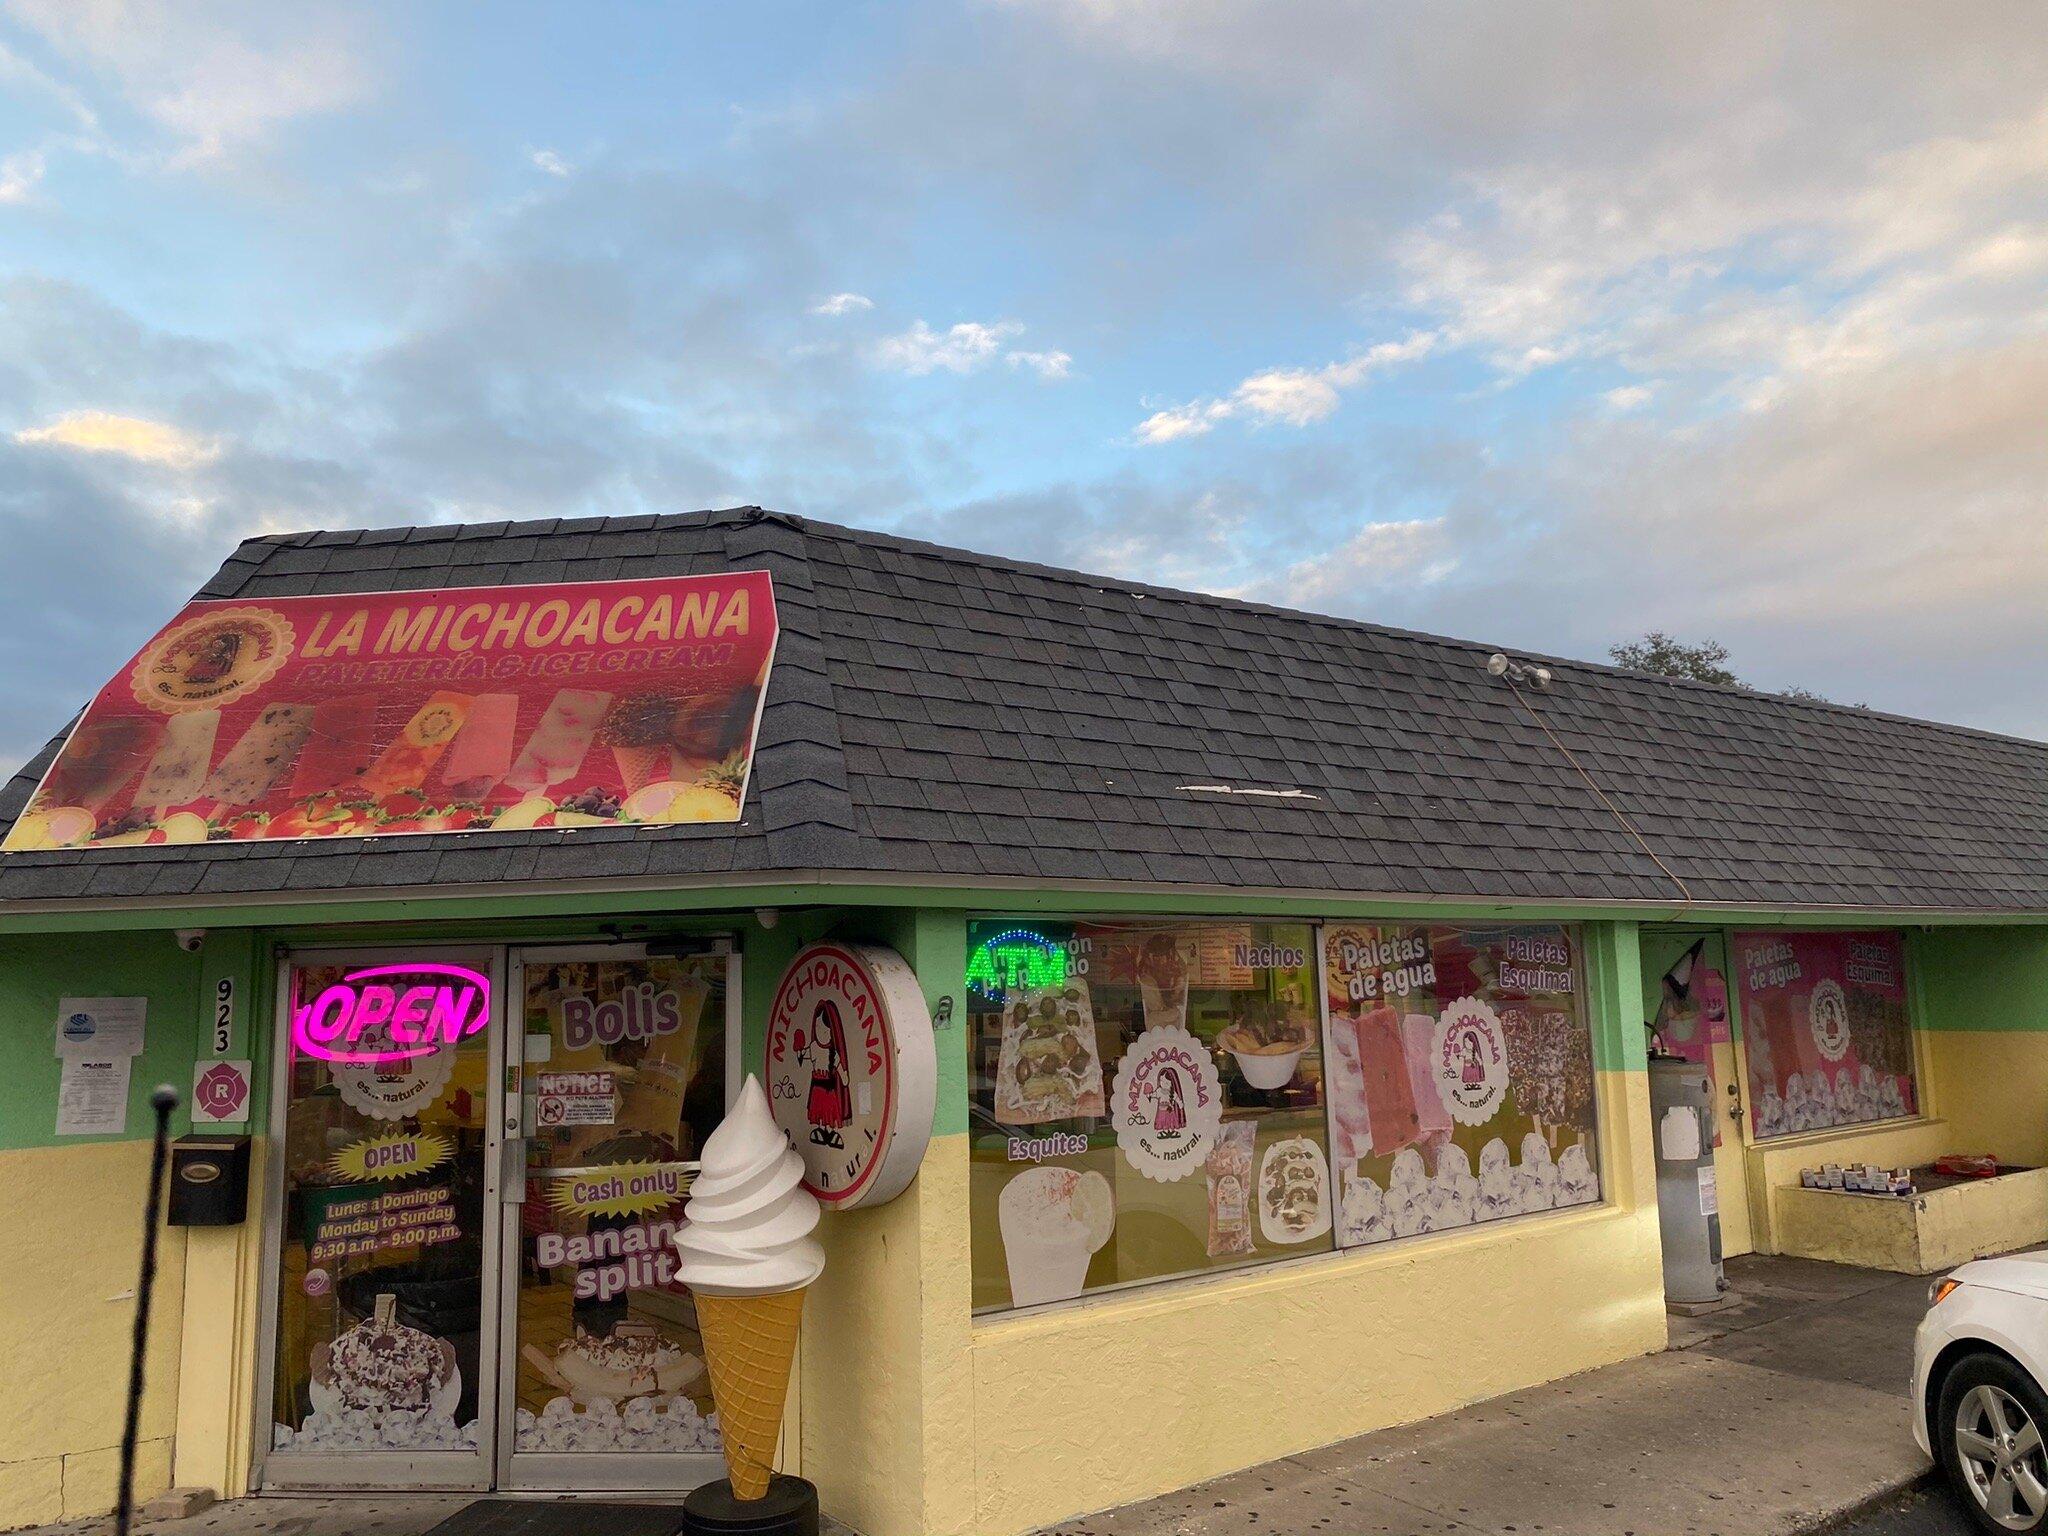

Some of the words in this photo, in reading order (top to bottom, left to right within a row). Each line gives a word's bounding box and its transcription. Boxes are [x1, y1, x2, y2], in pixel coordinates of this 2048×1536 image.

[300, 610, 369, 658] LA
[373, 588, 749, 654] MICHOACANA
[491, 654, 524, 679] &
[528, 652, 595, 676] ICE
[599, 642, 735, 673] CREAM
[182, 678, 244, 699] natural.
[965, 946, 1065, 987] ATM
[1234, 942, 1304, 968] Nachos
[1343, 936, 1425, 972] Paletas
[1506, 934, 1568, 966] Paletas
[1745, 941, 1794, 969] Paletas
[1349, 970, 1377, 1000] de
[1382, 962, 1437, 997] agua
[1499, 961, 1575, 995] Esquimal
[1750, 968, 1766, 991] de
[1769, 961, 1802, 988] agua
[215, 979, 232, 1053] 923
[308, 985, 476, 1044] OPEN
[563, 983, 681, 1049] Bolis
[772, 961, 883, 1075] MICHOACANA
[1442, 1014, 1501, 1068] MICHOACANA
[215, 1084, 228, 1099] R
[382, 1080, 429, 1103] natural.
[542, 1073, 611, 1094] NOTICE
[772, 1075, 801, 1100] La
[1128, 1046, 1210, 1112] MICHOACANA
[1469, 1086, 1497, 1109] natural.
[364, 1141, 416, 1169] OPEN
[1008, 1132, 1088, 1162] Esquites
[1163, 1132, 1202, 1161] natural.
[573, 1176, 624, 1204] Cash
[629, 1169, 678, 1195] only
[328, 1202, 368, 1219] Lunes
[371, 1200, 379, 1211] a
[383, 1189, 447, 1209] Domingo
[320, 1217, 378, 1239] Monday
[382, 1212, 396, 1229] to
[400, 1206, 454, 1226] Sunday
[314, 1244, 345, 1260] 9:30
[349, 1238, 378, 1254] a.m.
[392, 1229, 425, 1247] 9:00
[428, 1224, 460, 1244] p.m.
[537, 1219, 692, 1267] Banan
[574, 1253, 675, 1301] split
